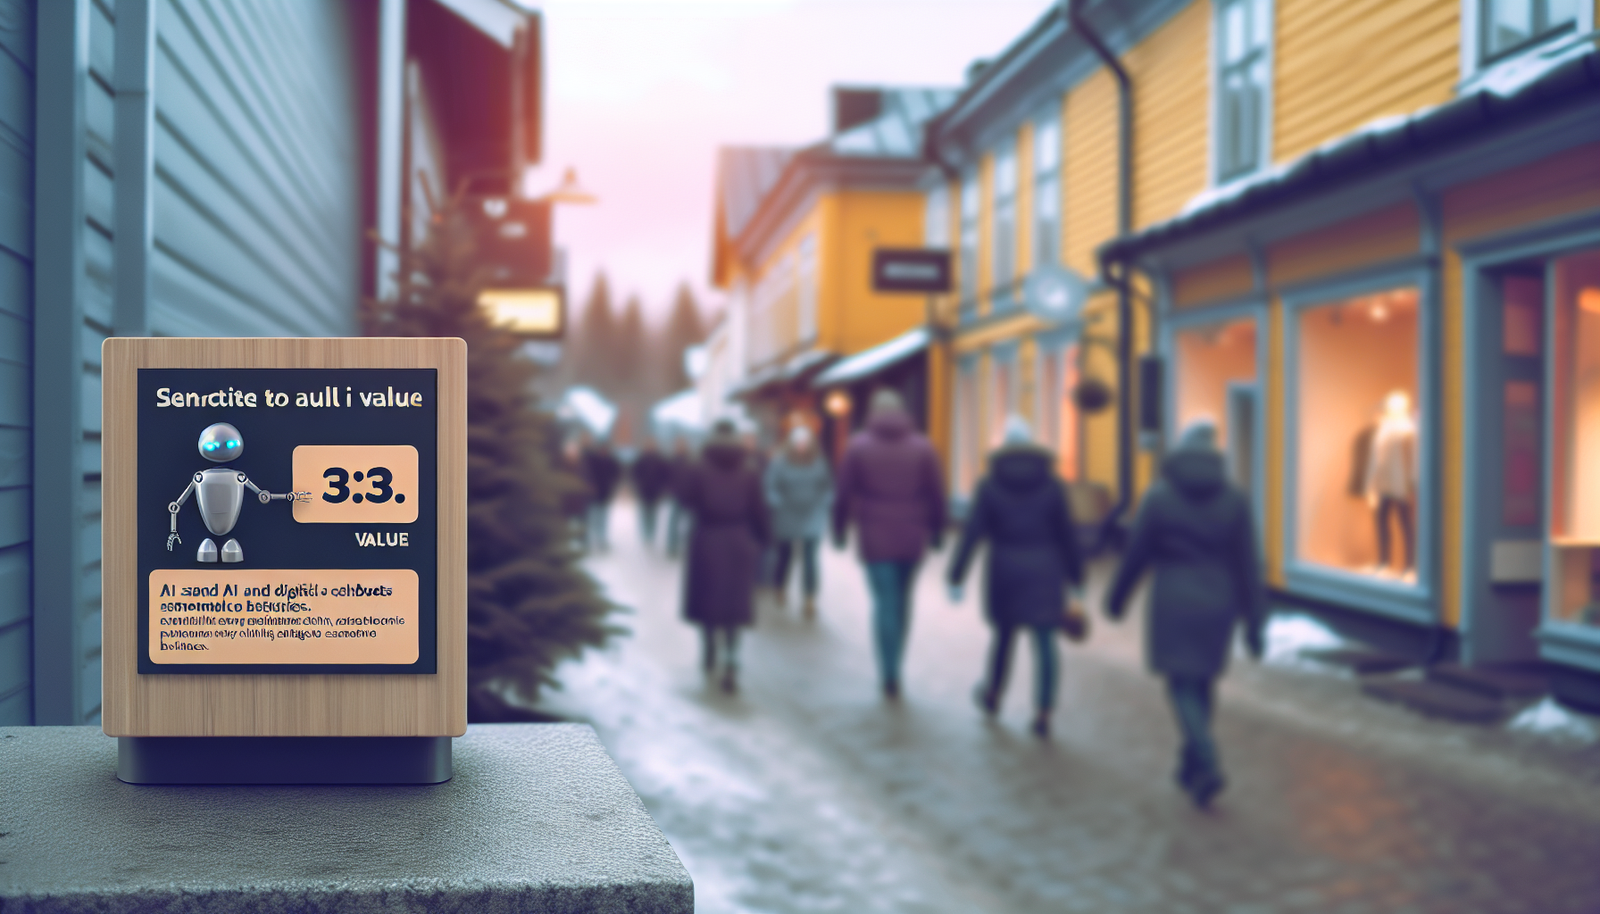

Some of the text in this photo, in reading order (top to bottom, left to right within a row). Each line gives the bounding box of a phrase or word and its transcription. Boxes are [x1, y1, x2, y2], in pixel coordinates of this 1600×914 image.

[264, 389, 289, 407] to
[359, 386, 423, 407] value
[354, 532, 409, 547] VALUE
[244, 583, 271, 597] and
